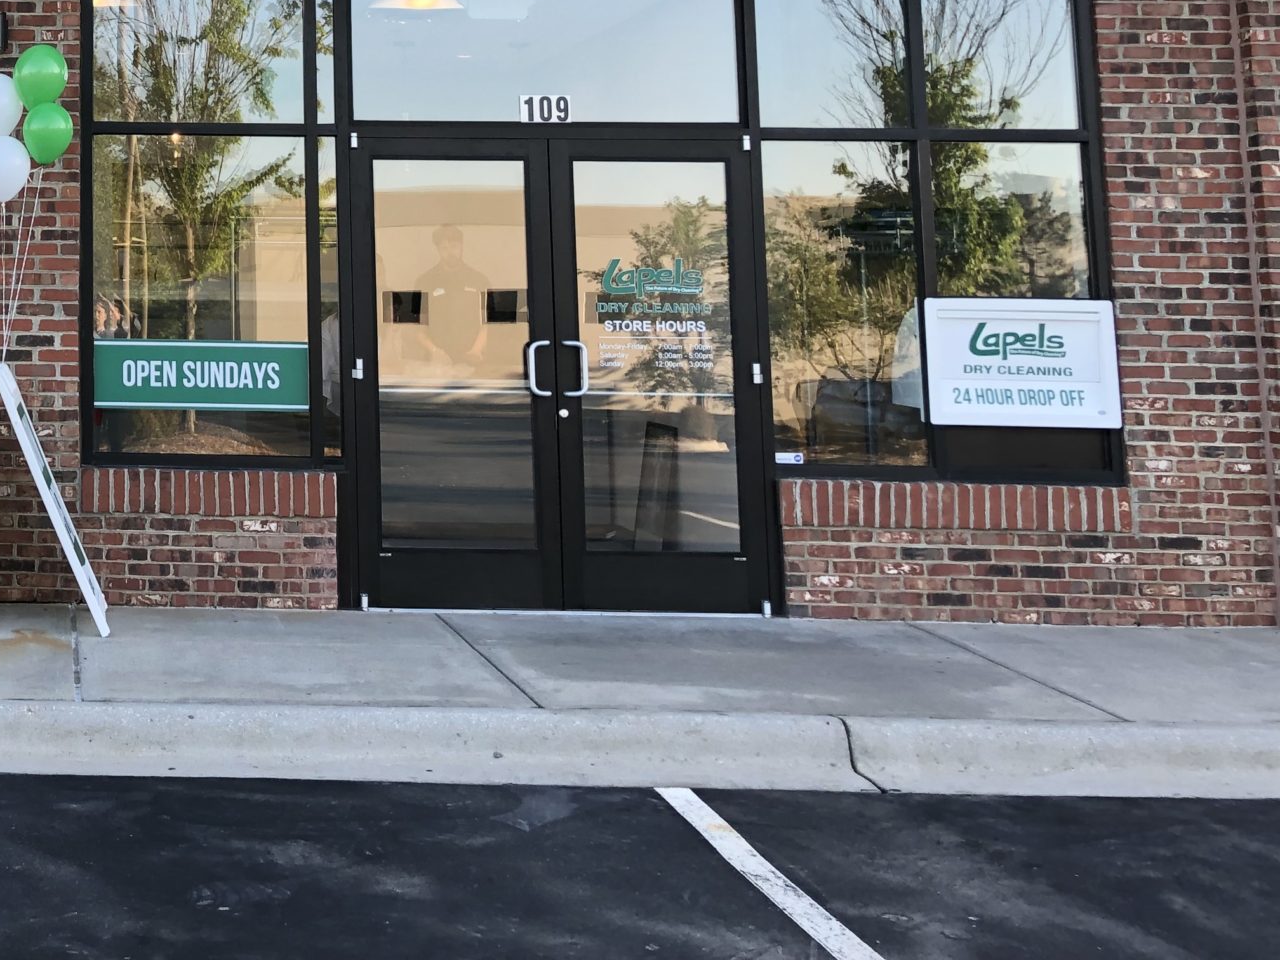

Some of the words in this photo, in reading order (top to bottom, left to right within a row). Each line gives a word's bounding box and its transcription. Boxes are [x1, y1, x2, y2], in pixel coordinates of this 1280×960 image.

[523, 95, 569, 122] 109
[602, 257, 704, 299] Lapels
[597, 302, 629, 313] DRY
[631, 302, 713, 315] CLEANING
[604, 320, 652, 332] STORE
[655, 320, 707, 333] HOURS
[969, 322, 1065, 360] Lapels
[600, 360, 625, 368] Sunday
[963, 364, 993, 375] DRY
[997, 365, 1073, 377] CLEANING
[122, 359, 177, 388] OPEN
[182, 360, 281, 390] SUNDAYS
[952, 387, 972, 404] 24
[976, 388, 1015, 406] HOUR
[1018, 388, 1056, 407] DROP
[1061, 389, 1085, 407] OFF
